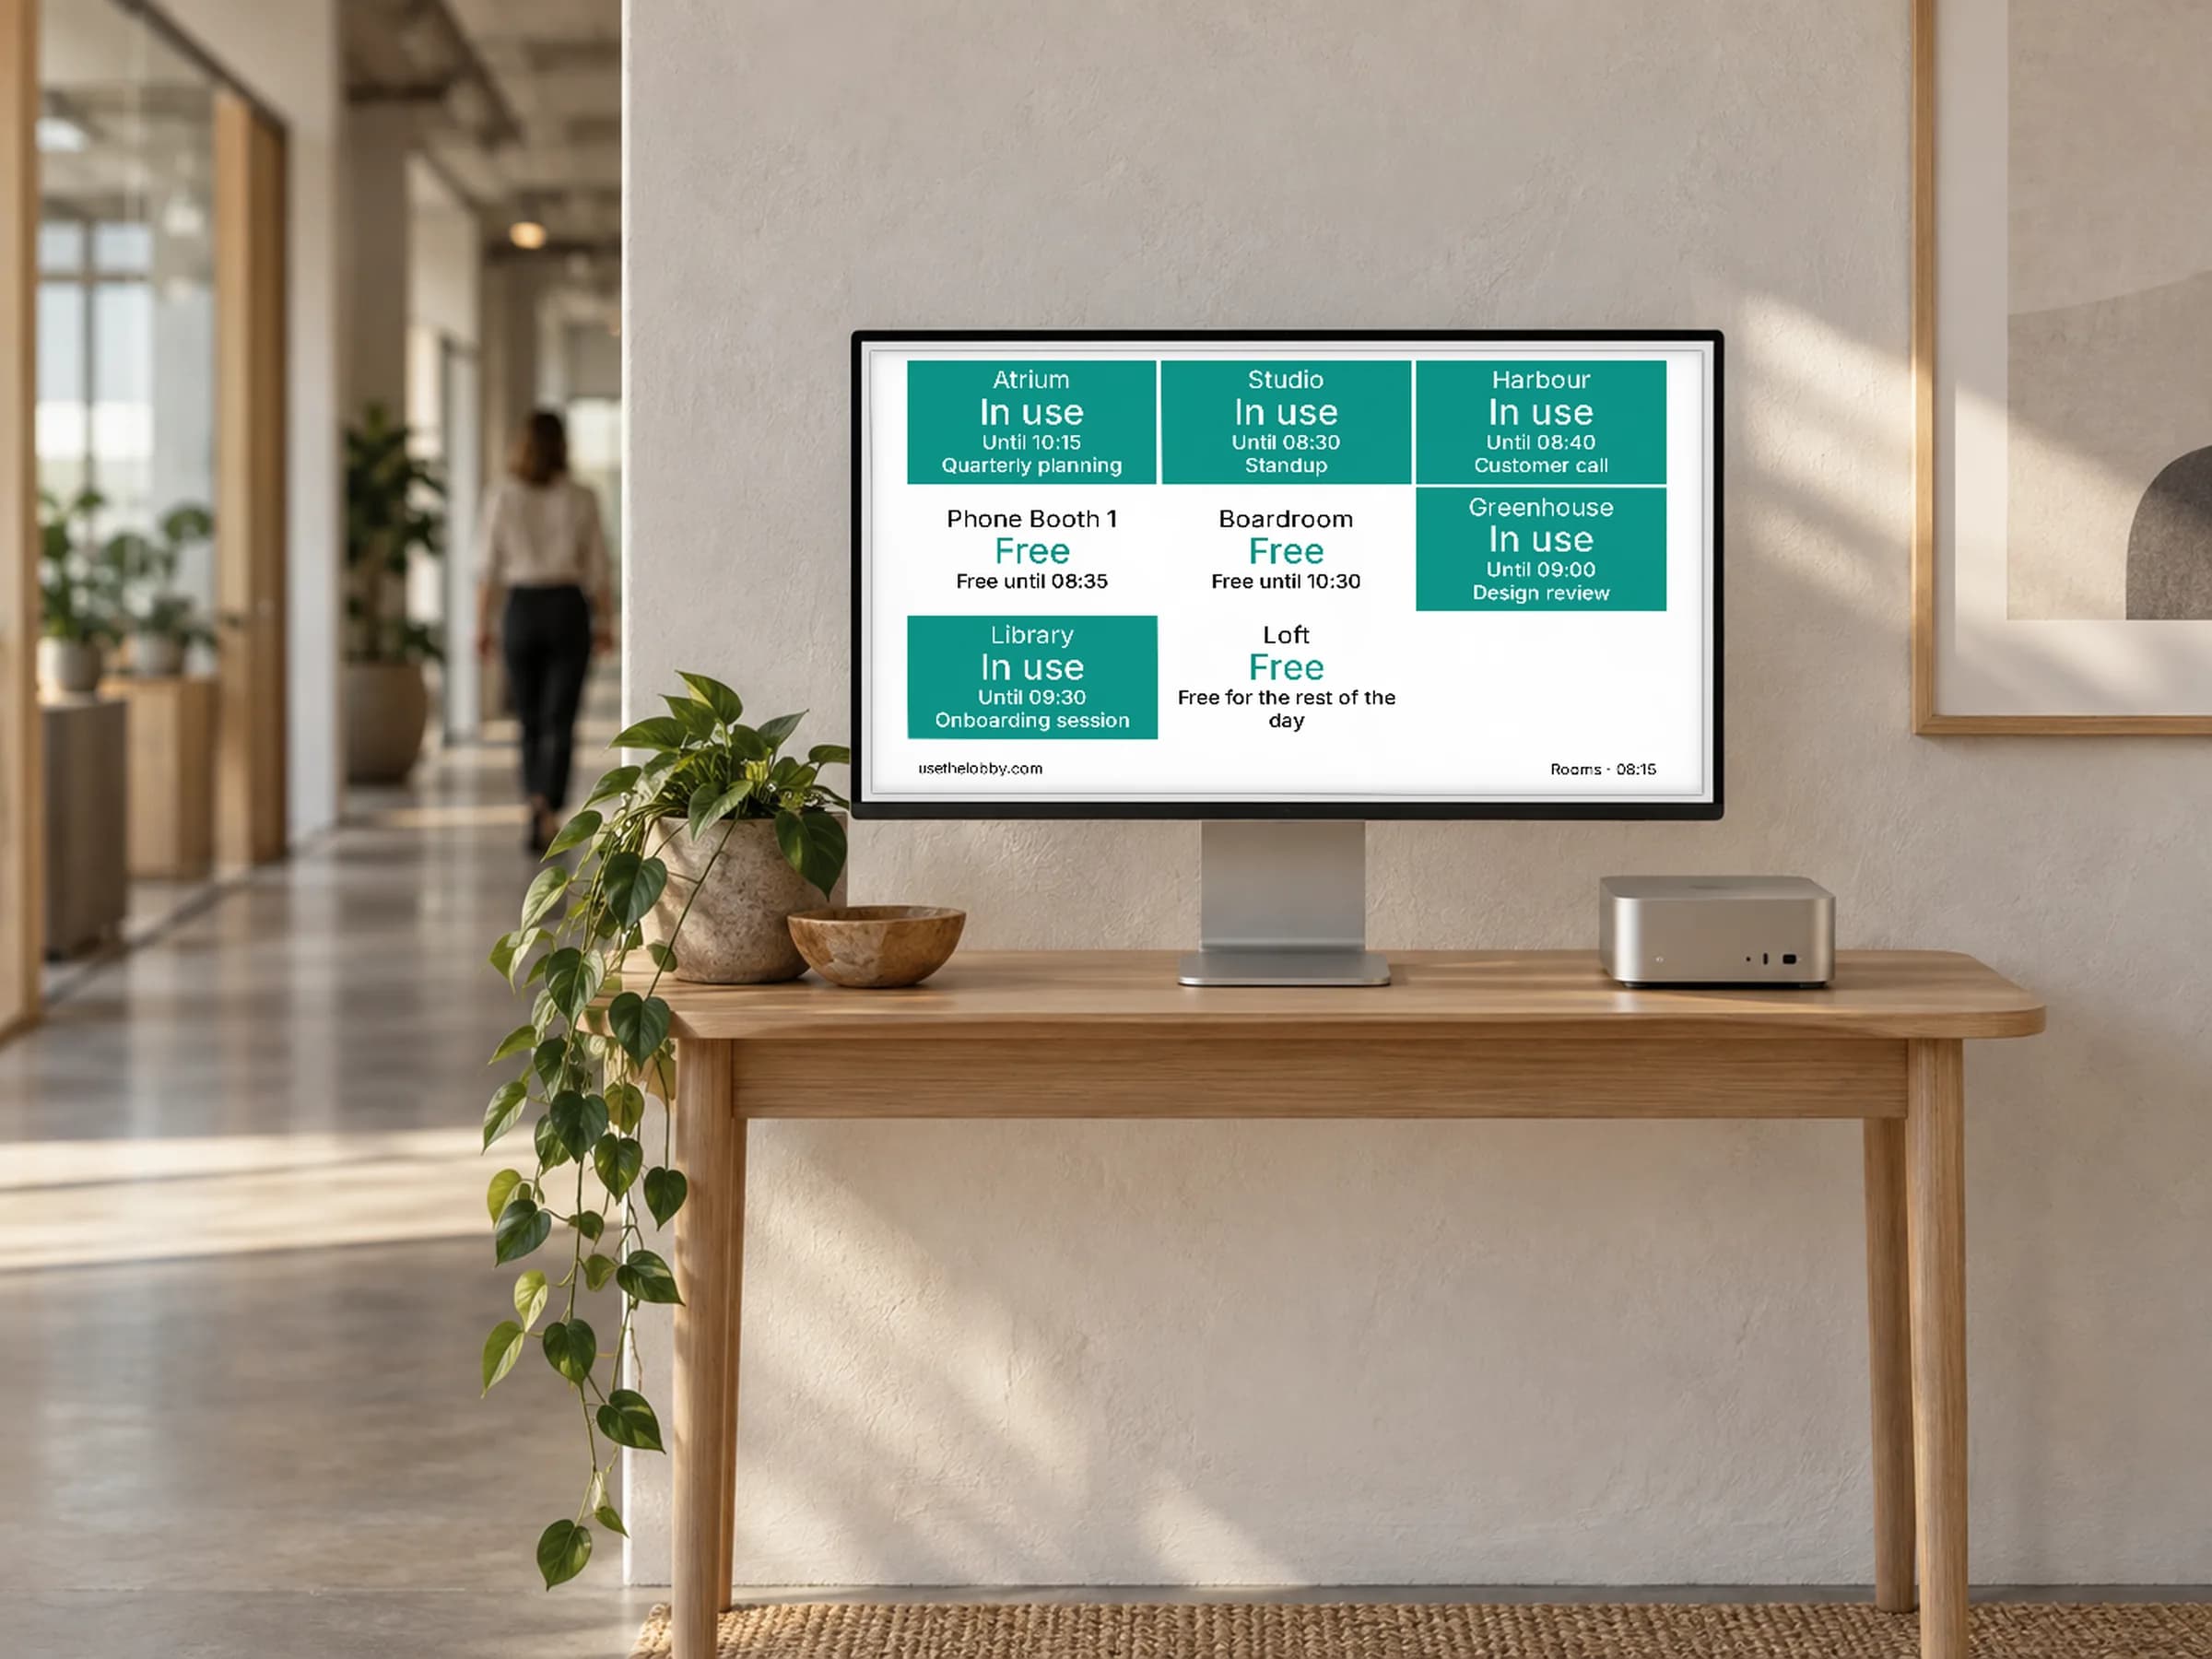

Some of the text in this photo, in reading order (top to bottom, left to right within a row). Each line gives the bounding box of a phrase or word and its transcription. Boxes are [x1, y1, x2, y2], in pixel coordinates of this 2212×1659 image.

[993, 369, 1069, 389] Atrium
[1249, 369, 1324, 389] Studio
[1493, 371, 1592, 389] Harbour
[981, 397, 1084, 426] In use
[1236, 397, 1338, 426] In use
[1490, 397, 1594, 426] In use
[982, 433, 1081, 451] Until 10:15
[1232, 433, 1341, 451] Until 08:30
[1487, 433, 1596, 451] Until 08:40
[942, 456, 1123, 477] Quarterly planning
[1245, 457, 1328, 477] Standup
[1475, 457, 1608, 473] Customer call
[1468, 497, 1614, 517] Greenhouse
[947, 509, 1116, 528] Phone Booth 1
[1219, 509, 1353, 529] Boardroom
[1490, 524, 1594, 553] In use
[996, 536, 1070, 565] Free
[1250, 536, 1324, 565] Free
[1487, 561, 1596, 578] Until 09:00
[957, 571, 1109, 590] Free until 08:35
[1212, 572, 1361, 590] Free until 10:30
[1473, 584, 1611, 605] Design review
[992, 624, 1075, 649] Library
[1264, 624, 1311, 644] Loft
[982, 653, 1084, 681] In use
[1250, 653, 1324, 681] Free
[978, 688, 1087, 705] Until 09:30
[1178, 688, 1396, 706] Free for the rest of the
[935, 711, 1130, 732] Onboarding session
[1268, 712, 1306, 733] day
[918, 761, 1043, 777] usethelobby.com
[1551, 762, 1602, 776] Rooms
[1617, 762, 1657, 776] 08:15
